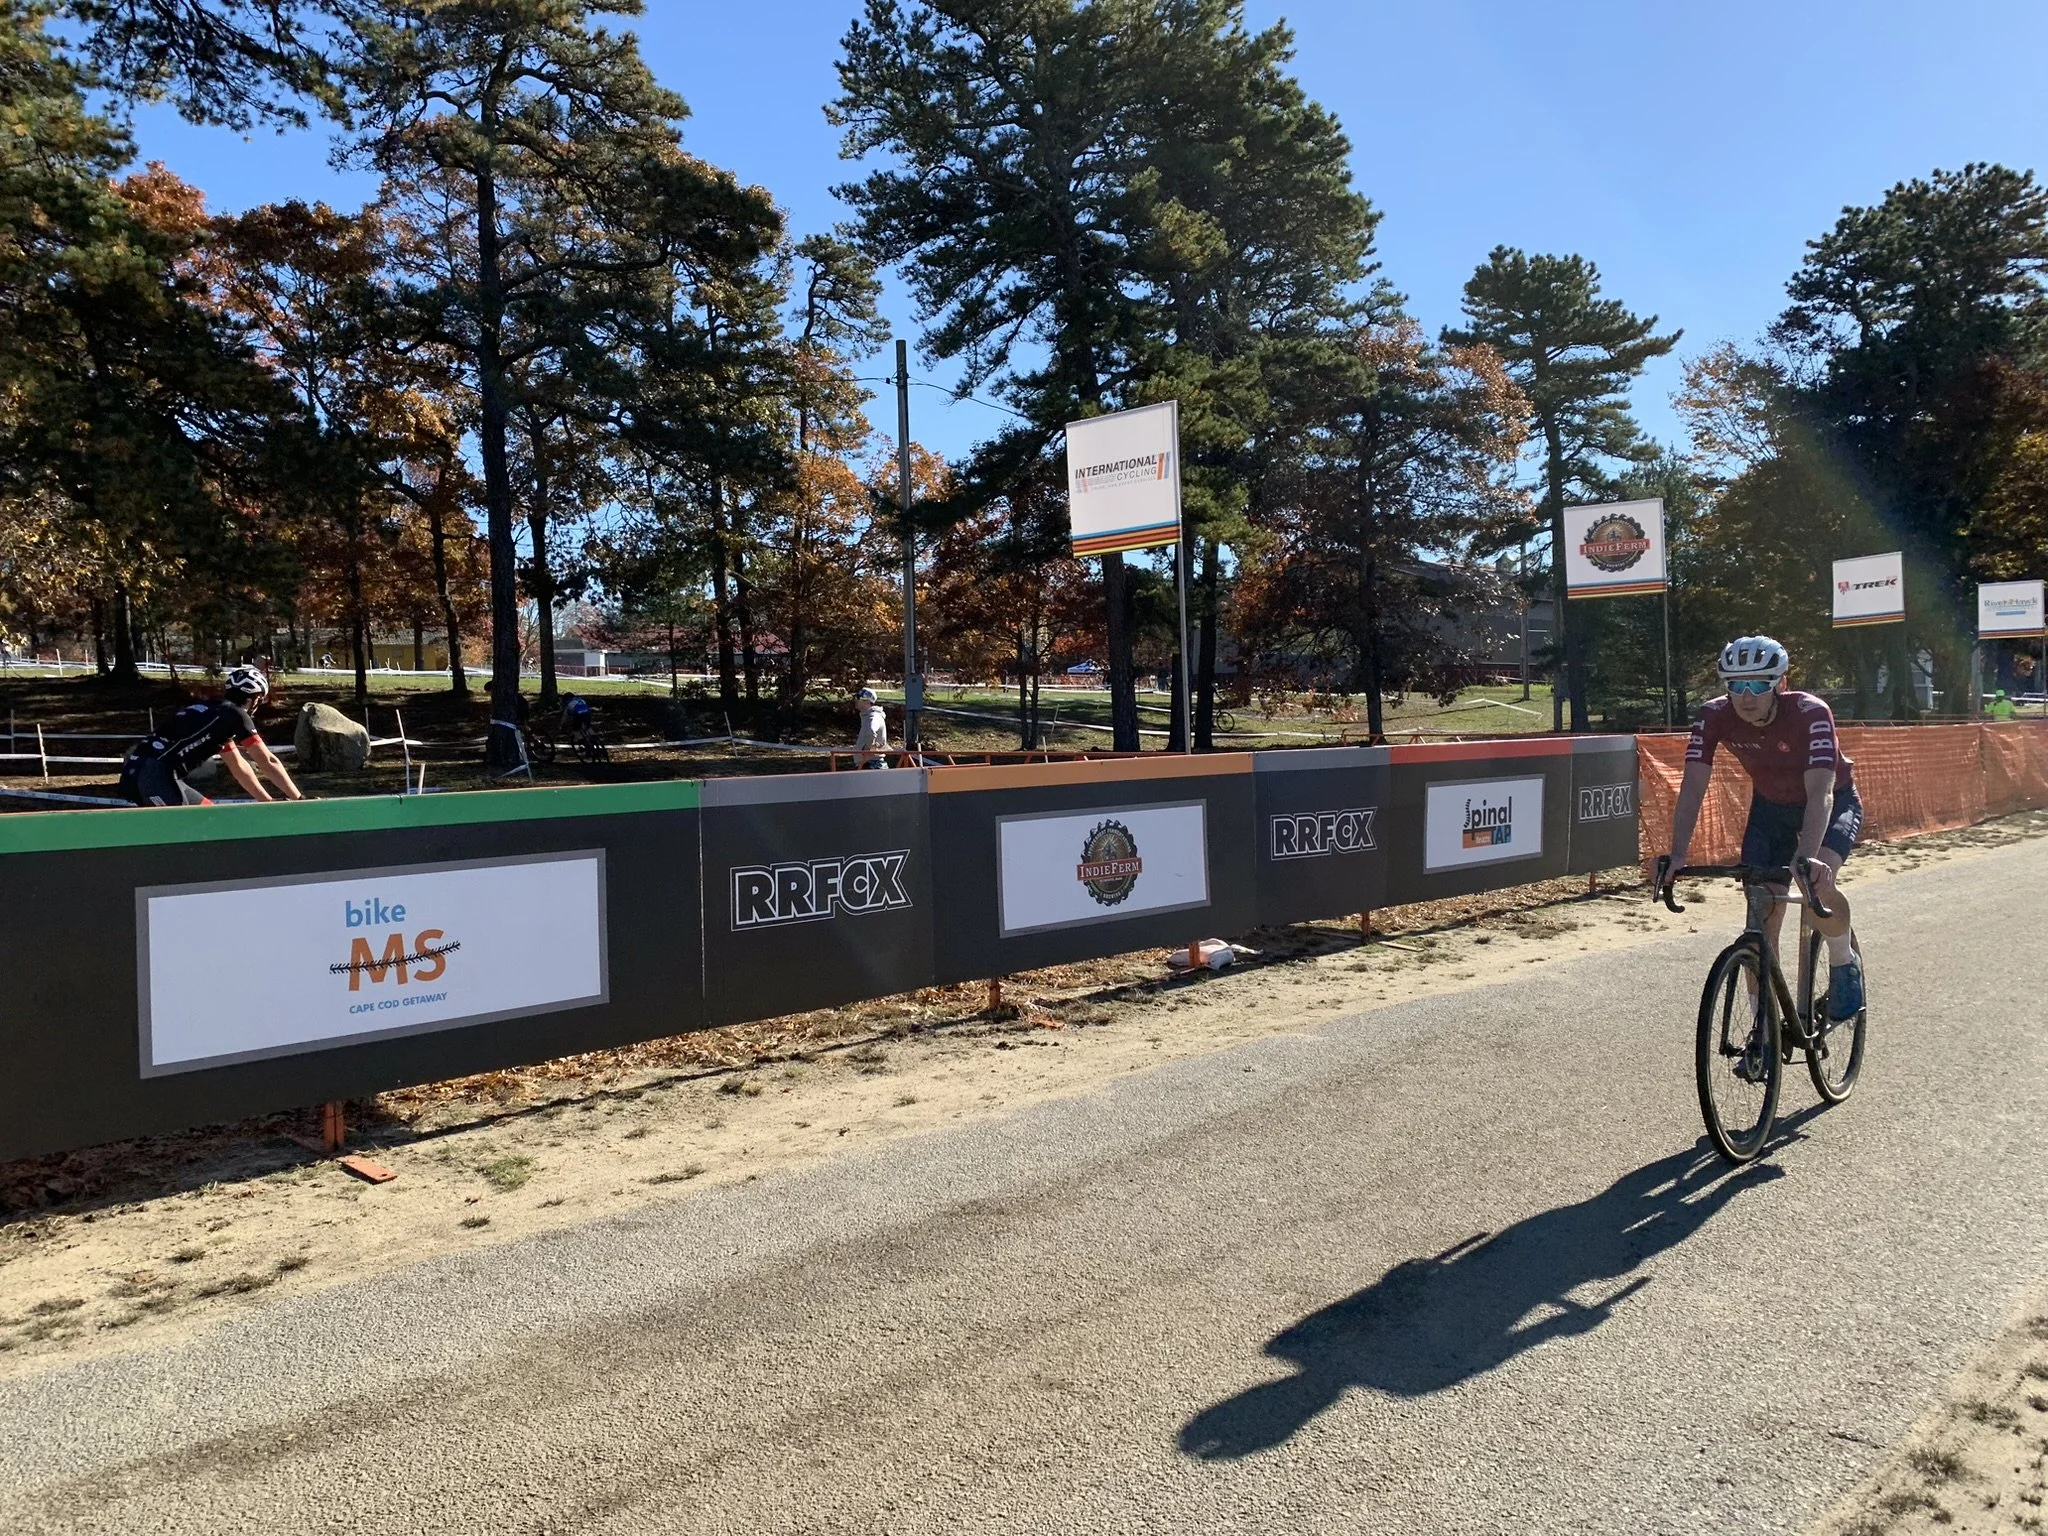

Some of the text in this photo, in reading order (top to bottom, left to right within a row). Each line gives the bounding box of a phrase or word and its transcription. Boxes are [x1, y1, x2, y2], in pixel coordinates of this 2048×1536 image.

[1075, 455, 1157, 479] INTERNATIONAL
[1116, 467, 1157, 481] CYCLING
[1853, 577, 1898, 590] TREK
[177, 733, 211, 757] TREK
[1809, 720, 1834, 765] TBD
[1579, 784, 1631, 821] RRFCX
[1272, 809, 1375, 858] RRFCX
[733, 852, 910, 928] RRFCX
[345, 897, 406, 928] bike
[348, 929, 447, 991] MS
[349, 992, 448, 1014] CAPE COD GETAWAY
